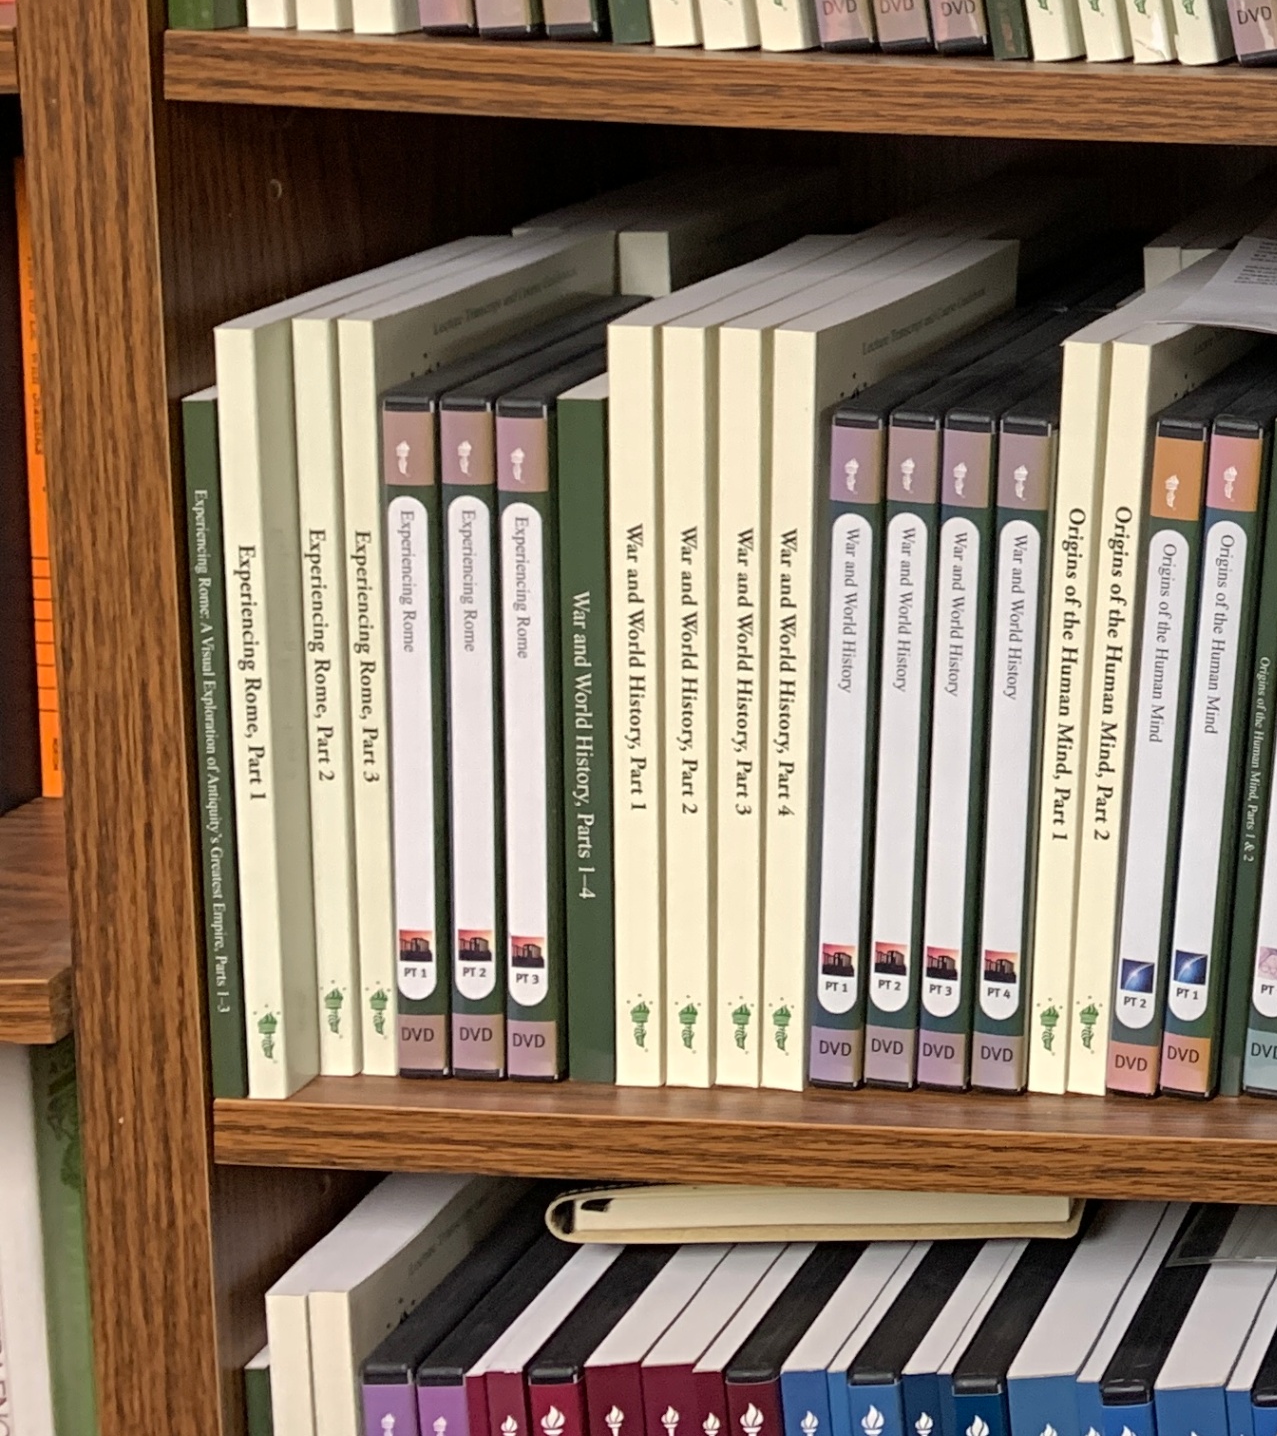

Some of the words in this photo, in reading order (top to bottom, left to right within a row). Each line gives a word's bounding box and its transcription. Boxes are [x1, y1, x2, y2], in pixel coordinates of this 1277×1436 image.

[1060, 506, 1087, 580] Origins
[232, 544, 261, 672] Experiencing
[572, 590, 592, 630] War
[1063, 584, 1083, 609] of
[1061, 610, 1082, 642] the
[572, 632, 593, 668] and
[573, 672, 594, 730] World
[1057, 645, 1080, 718] Human
[243, 676, 263, 740] Rome,
[246, 745, 266, 785] Part
[571, 734, 595, 808] History,
[1052, 722, 1076, 781] Mind,
[249, 792, 268, 801] 1
[1051, 786, 1072, 827] Part
[576, 812, 596, 860] Parts
[1051, 832, 1069, 841] 1
